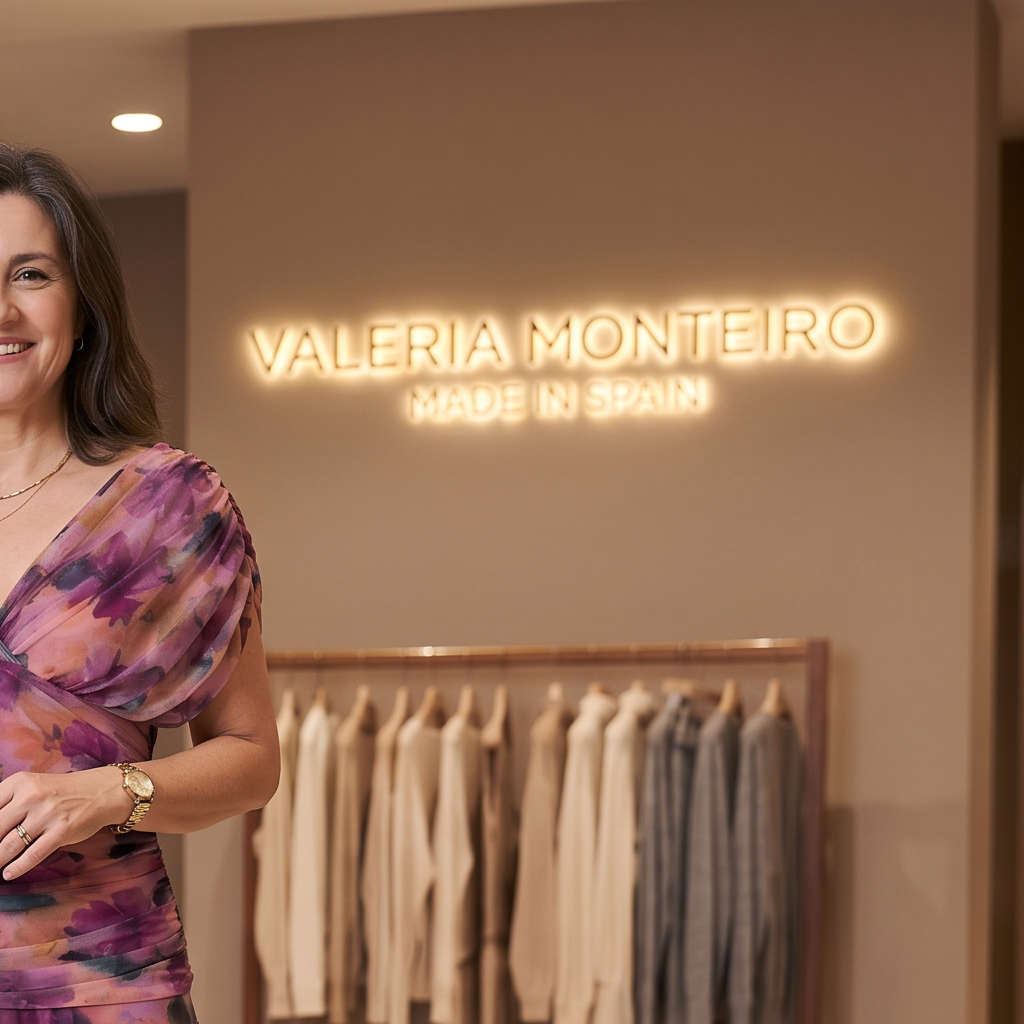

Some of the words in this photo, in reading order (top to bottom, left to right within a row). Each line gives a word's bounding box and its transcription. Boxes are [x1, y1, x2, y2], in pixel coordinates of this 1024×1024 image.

[249, 320, 504, 373] VALERIA
[528, 304, 877, 363] MONTEIRO
[409, 384, 524, 421] MADE
[536, 381, 575, 418] IN
[585, 377, 705, 416] SPAIN
